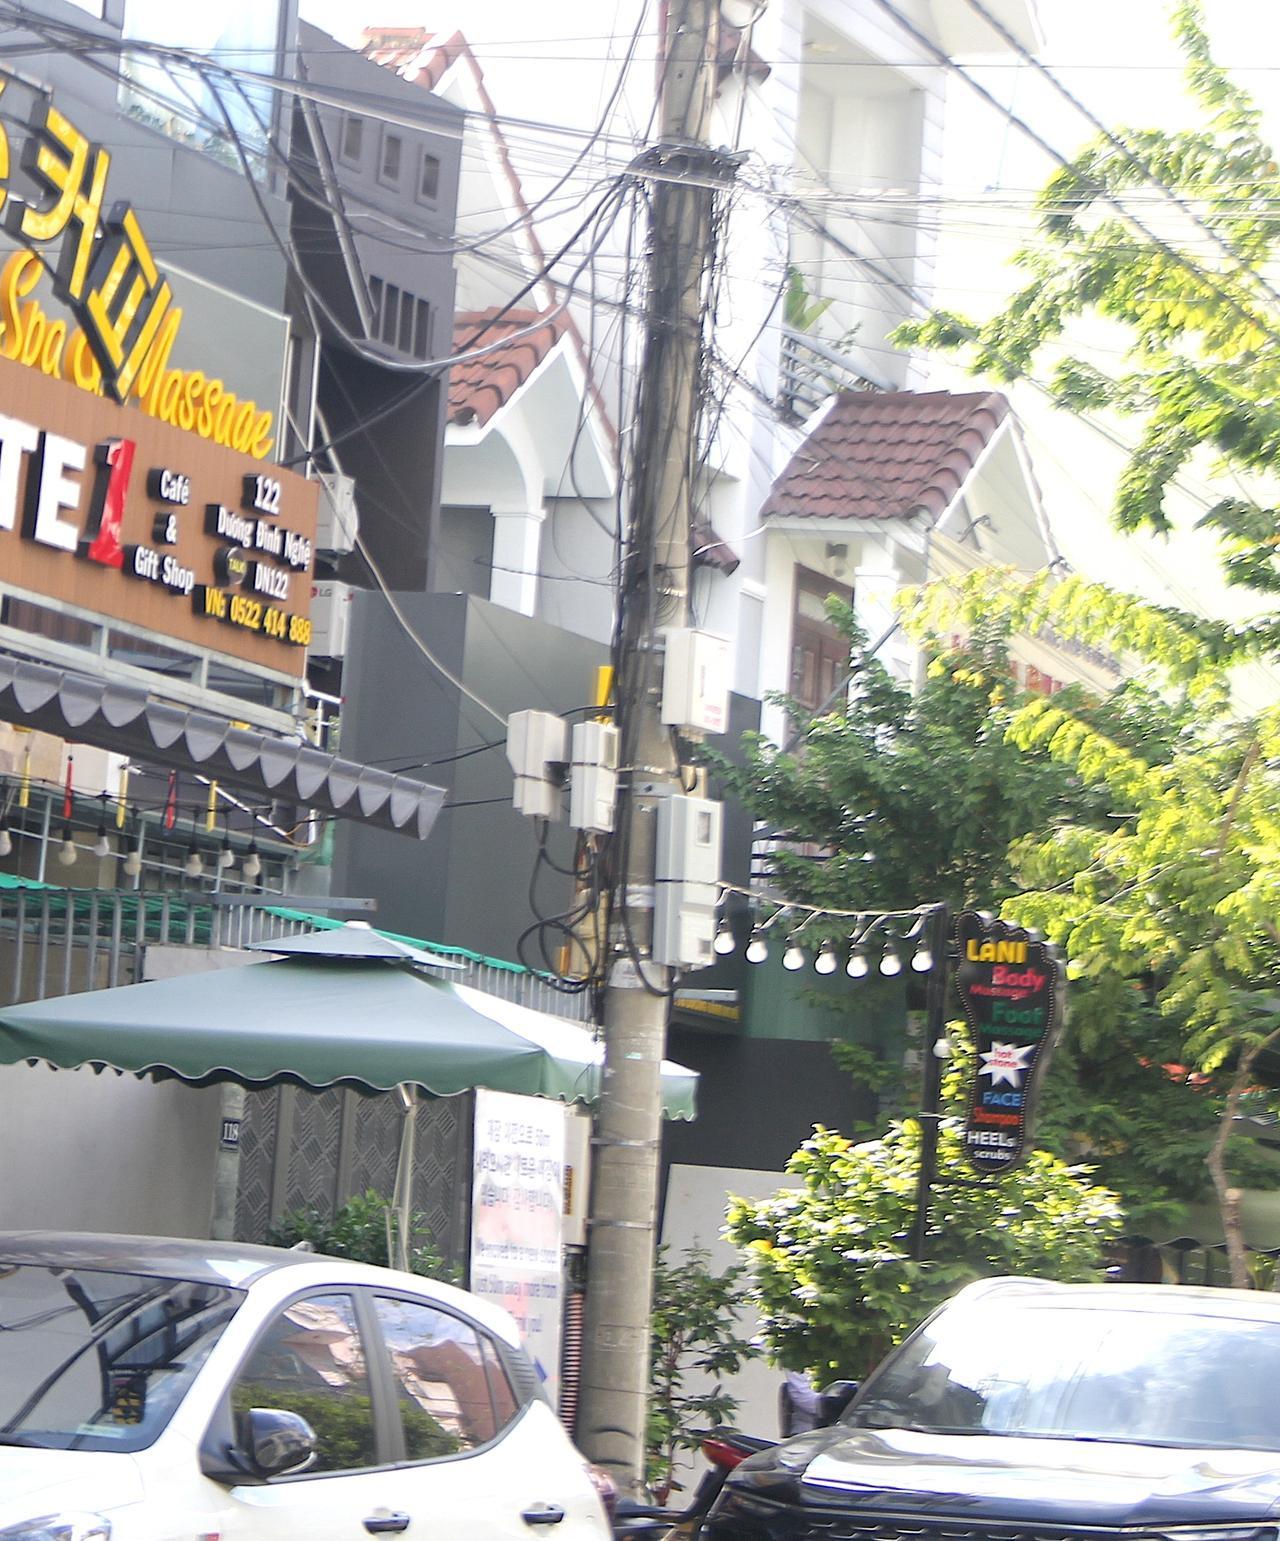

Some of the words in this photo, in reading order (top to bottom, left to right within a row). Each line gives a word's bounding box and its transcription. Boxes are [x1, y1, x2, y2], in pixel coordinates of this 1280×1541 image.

[20, 105, 173, 400] 커피
[160, 470, 191, 505] Café
[254, 475, 282, 515] 122
[87, 437, 137, 569] 1
[166, 512, 177, 545] &
[134, 545, 159, 581] Gift
[163, 556, 194, 594] Shop
[254, 562, 290, 600] DN122
[318, 587, 332, 598] LG
[230, 596, 261, 629] 0522
[264, 605, 286, 640] 414
[289, 616, 312, 645] 888
[966, 939, 1027, 964] LANI
[992, 965, 1047, 993] Body
[993, 1001, 1044, 1025] Foot
[990, 1059, 1018, 1069] stone
[994, 1047, 1012, 1058] hot
[982, 1091, 1021, 1107] FACE
[223, 1122, 239, 1141] 118
[973, 1149, 1012, 1160] scrubs
